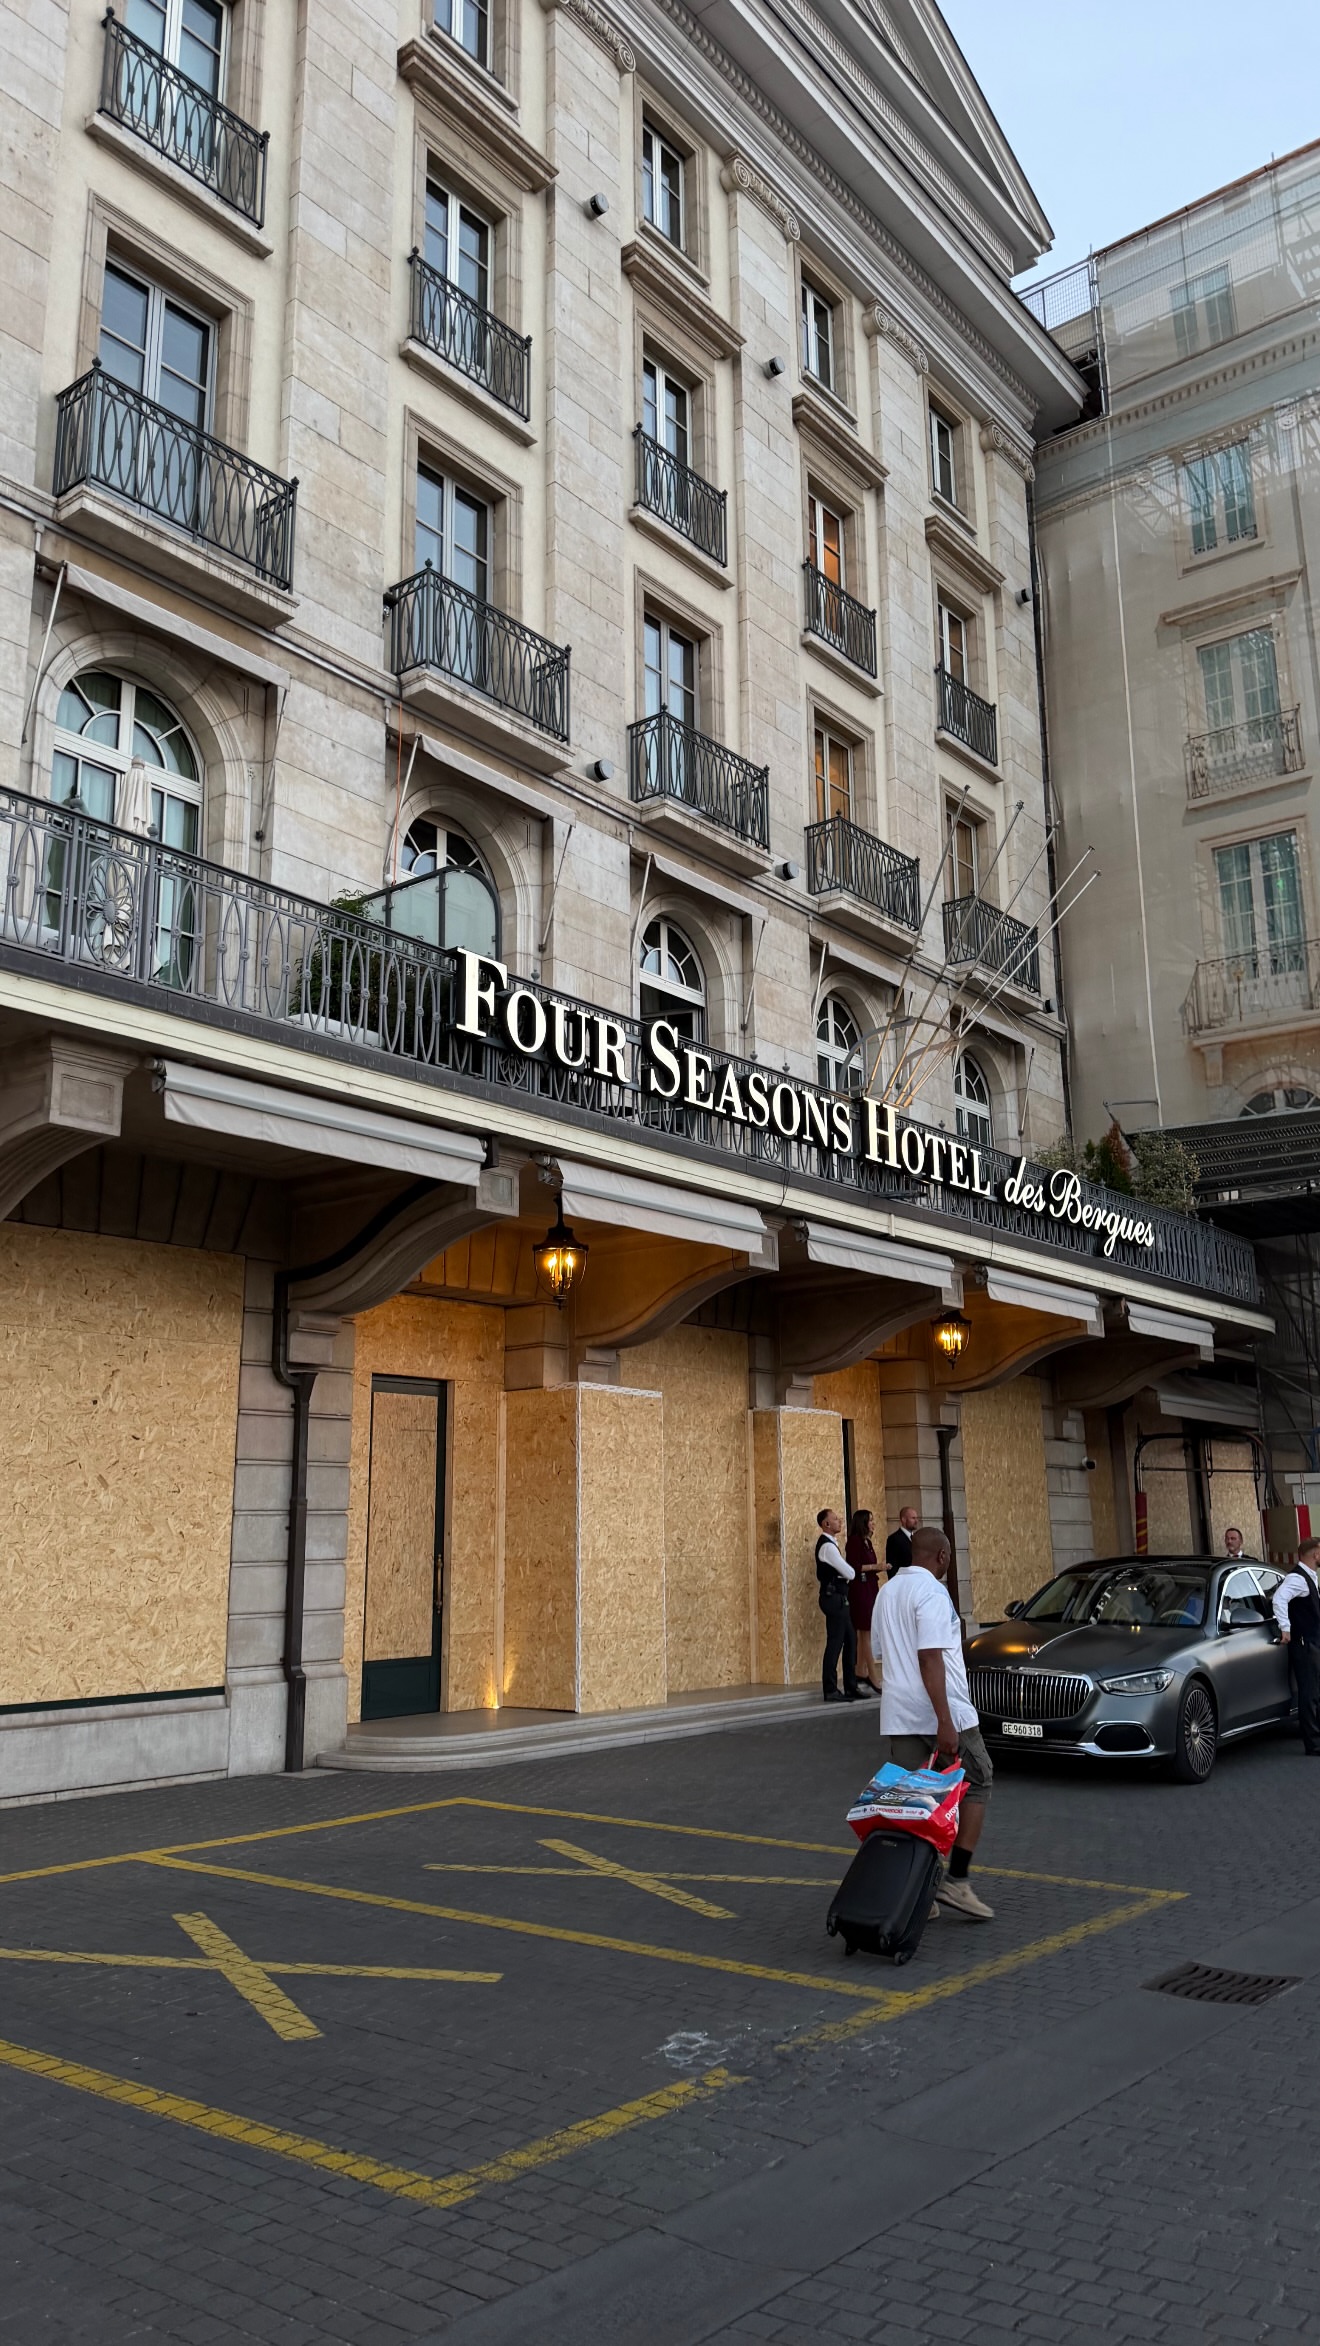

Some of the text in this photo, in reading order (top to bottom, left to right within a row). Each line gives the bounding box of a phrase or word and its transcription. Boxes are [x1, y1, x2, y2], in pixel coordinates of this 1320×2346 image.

[456, 947, 1155, 1257] FOUR SEASONS HOTEL des Bergues
